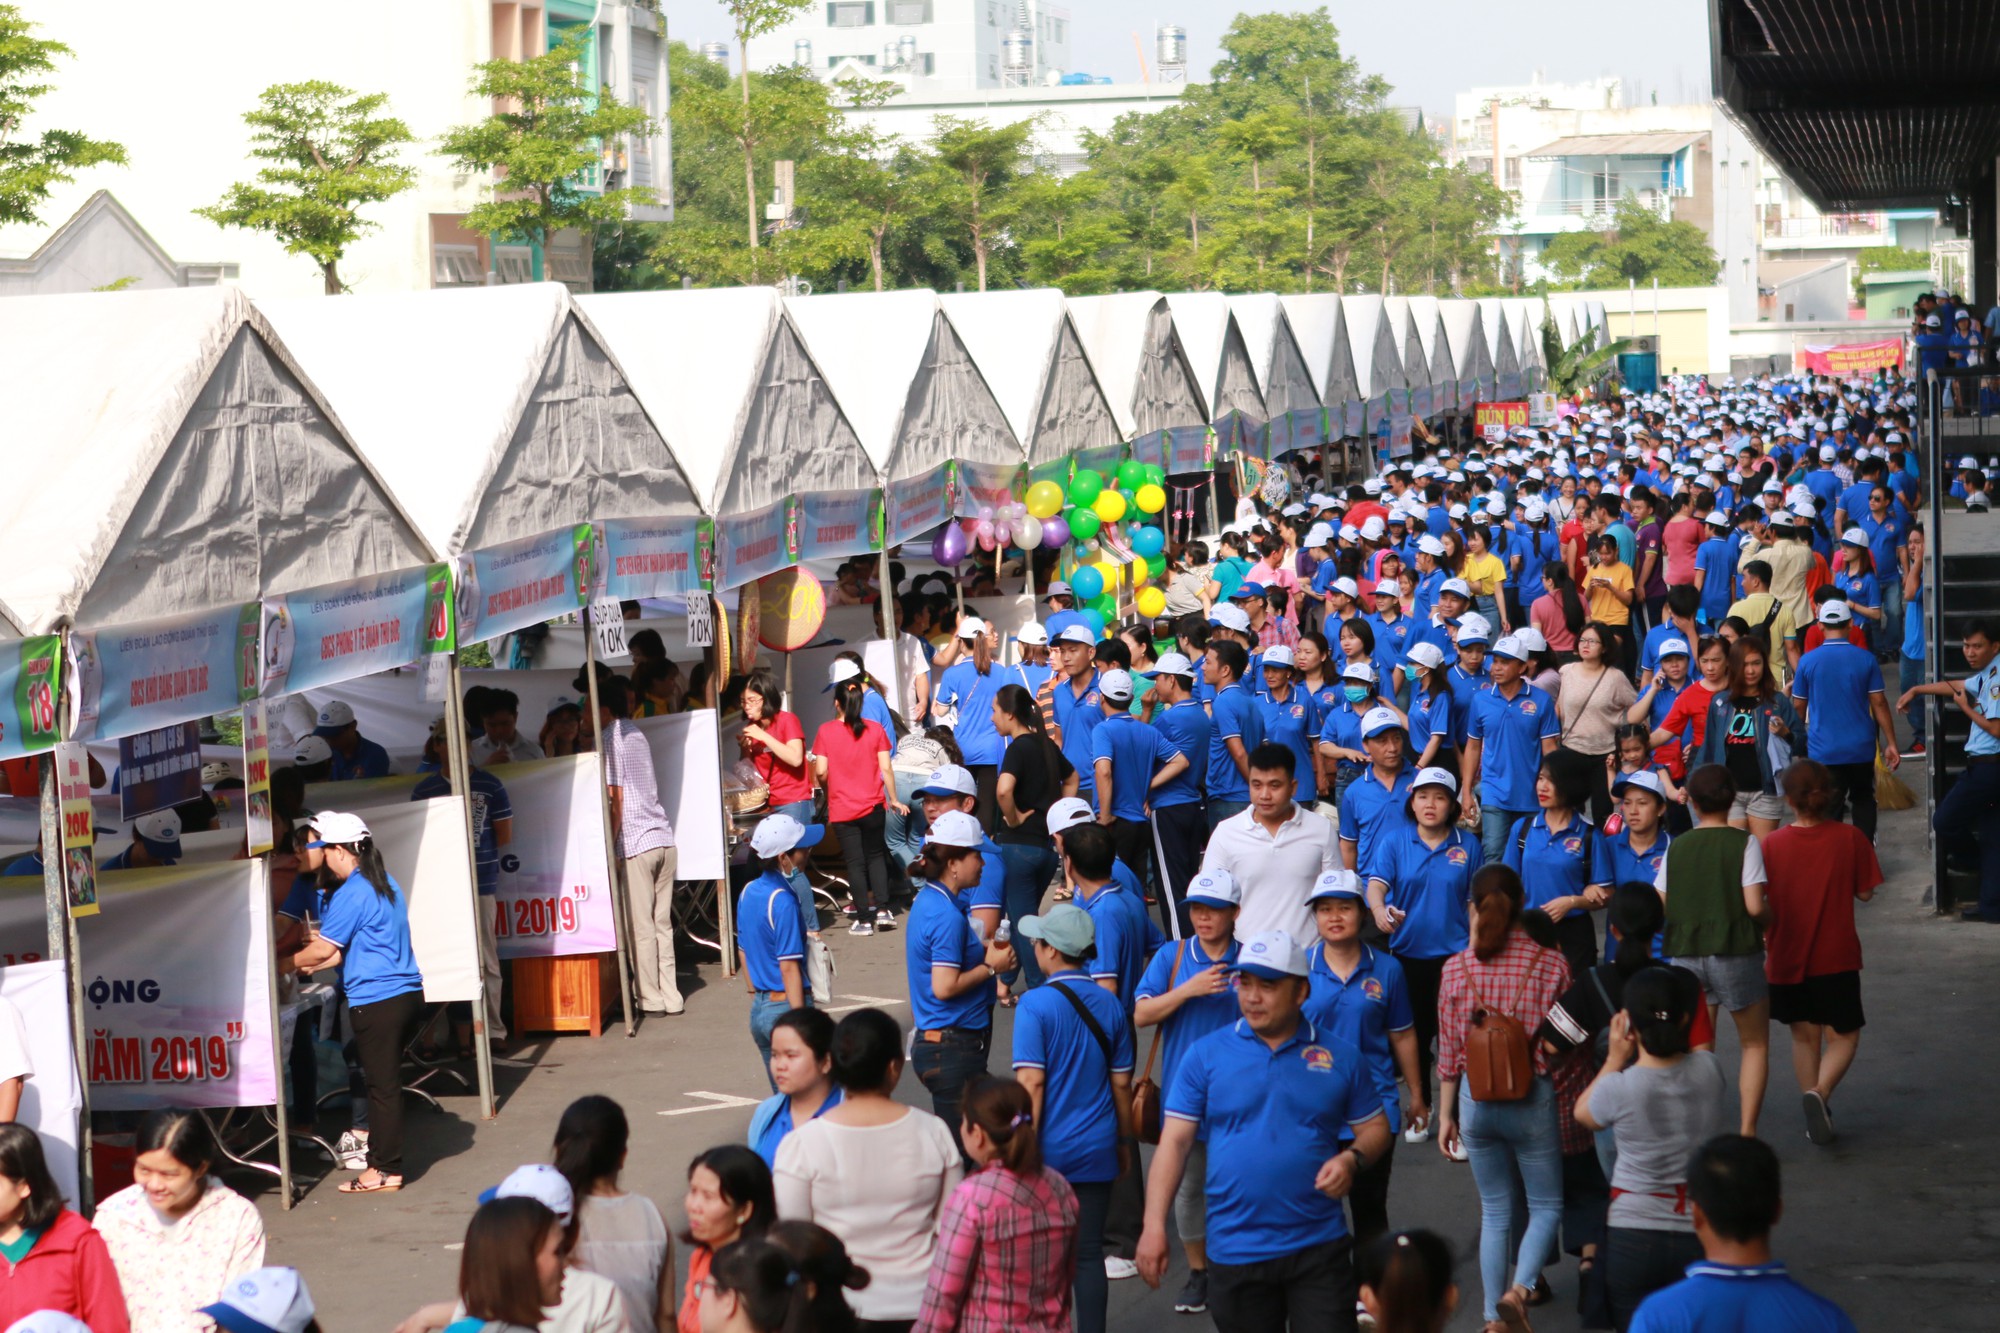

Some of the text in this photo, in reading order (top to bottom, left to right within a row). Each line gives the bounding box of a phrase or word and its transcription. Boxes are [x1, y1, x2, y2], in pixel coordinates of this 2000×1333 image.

[1477, 406, 1504, 425] BÚN
[1508, 406, 1526, 425] BÒ
[310, 599, 324, 614] LIÊN
[760, 582, 823, 624] 20K
[428, 600, 448, 641] 20
[691, 619, 712, 643] 10K
[120, 636, 134, 652] LIÊN
[600, 626, 625, 655] 10K
[28, 680, 53, 734] 18
[248, 760, 267, 785] 20K
[66, 811, 90, 838] 20K
[80, 976, 161, 1010] ỘNG
